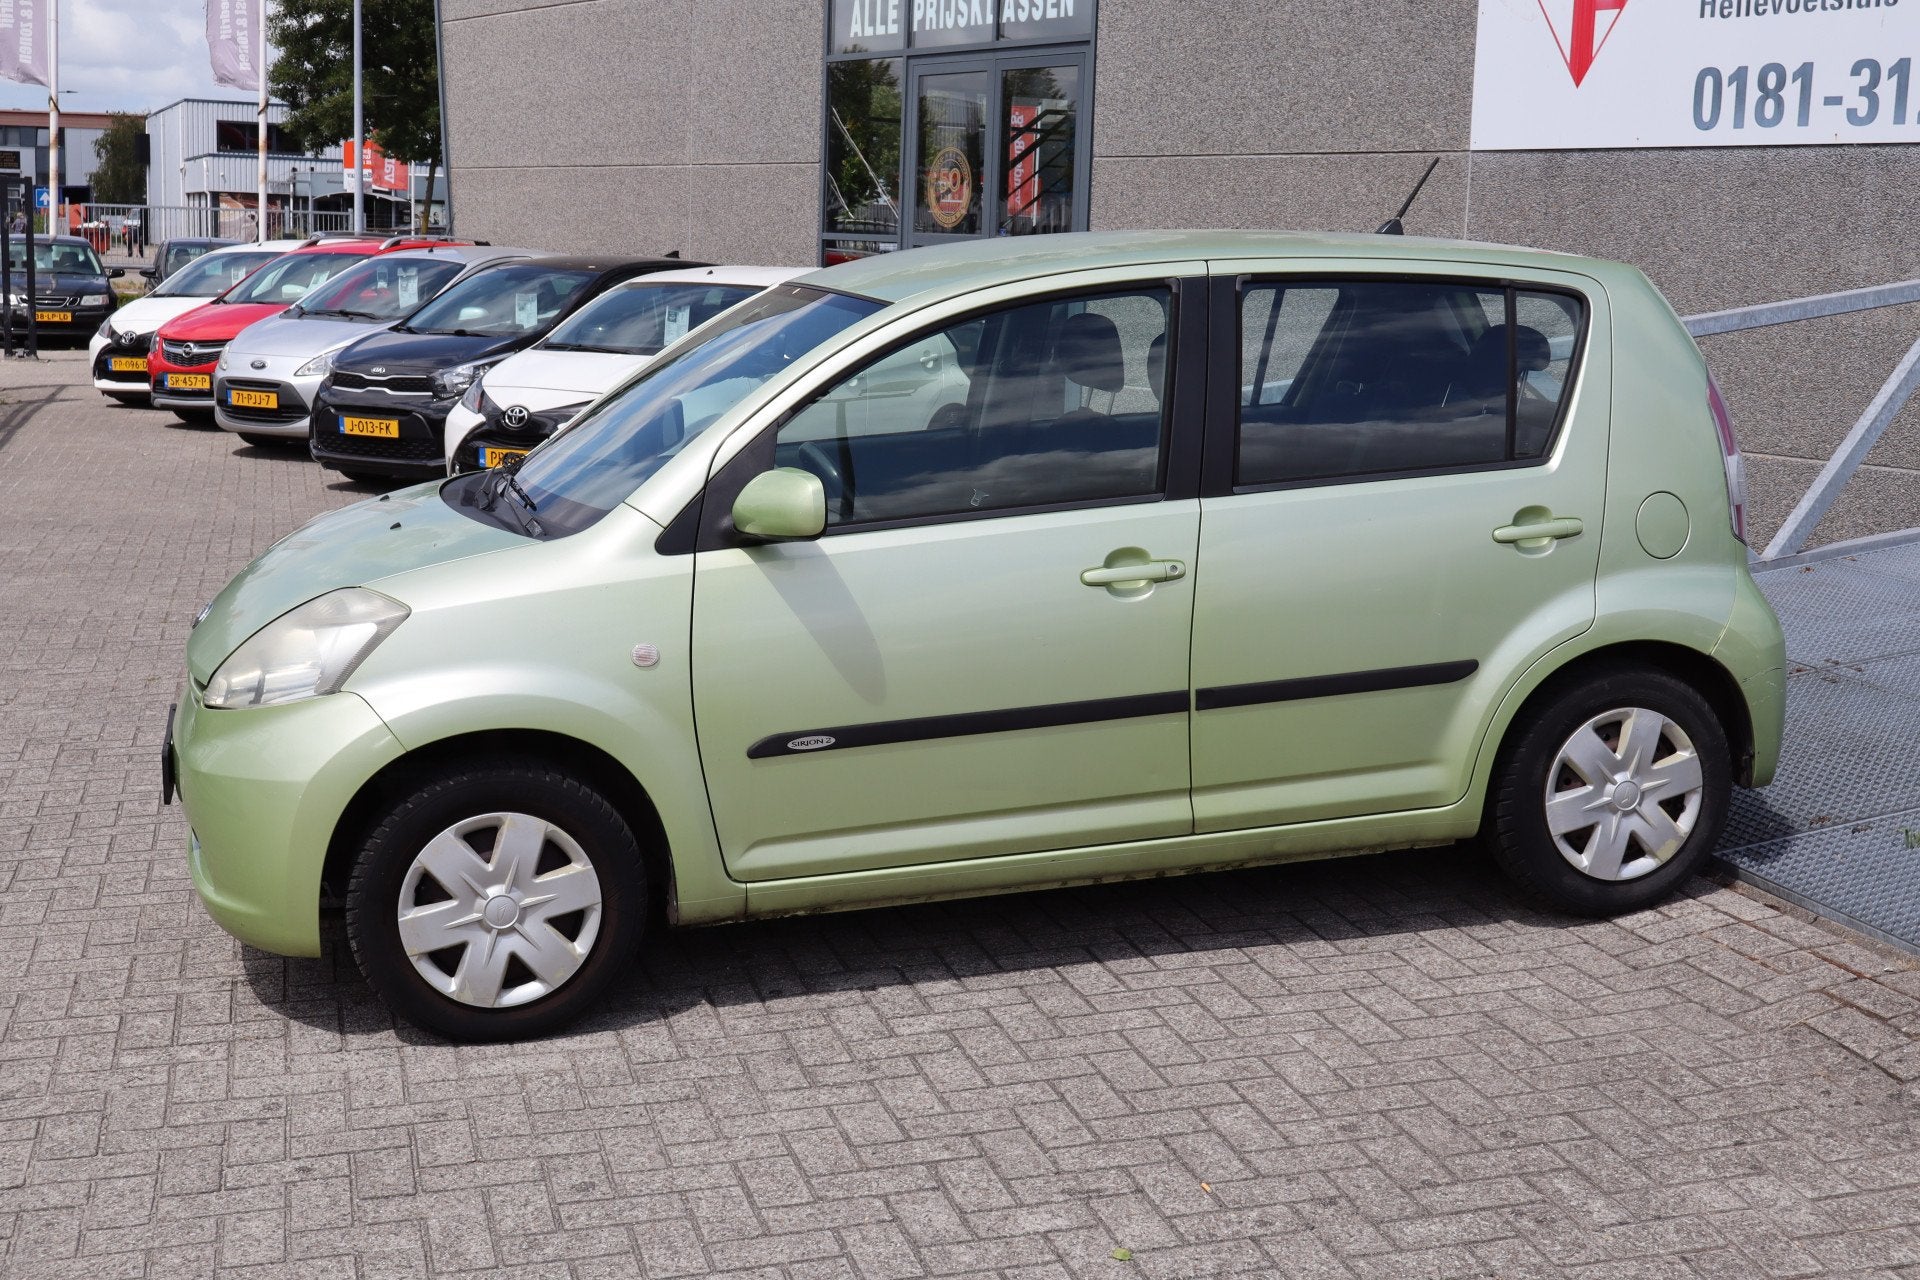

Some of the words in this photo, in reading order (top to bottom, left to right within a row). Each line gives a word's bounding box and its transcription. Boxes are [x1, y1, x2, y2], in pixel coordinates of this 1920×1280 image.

[850, 0, 899, 38] ALLE
[1693, 57, 1920, 131] 0181-31
[169, 376, 207, 387] SR-457-P
[235, 392, 271, 406] 71-PJJ-7
[349, 420, 392, 435] J-013-FK
